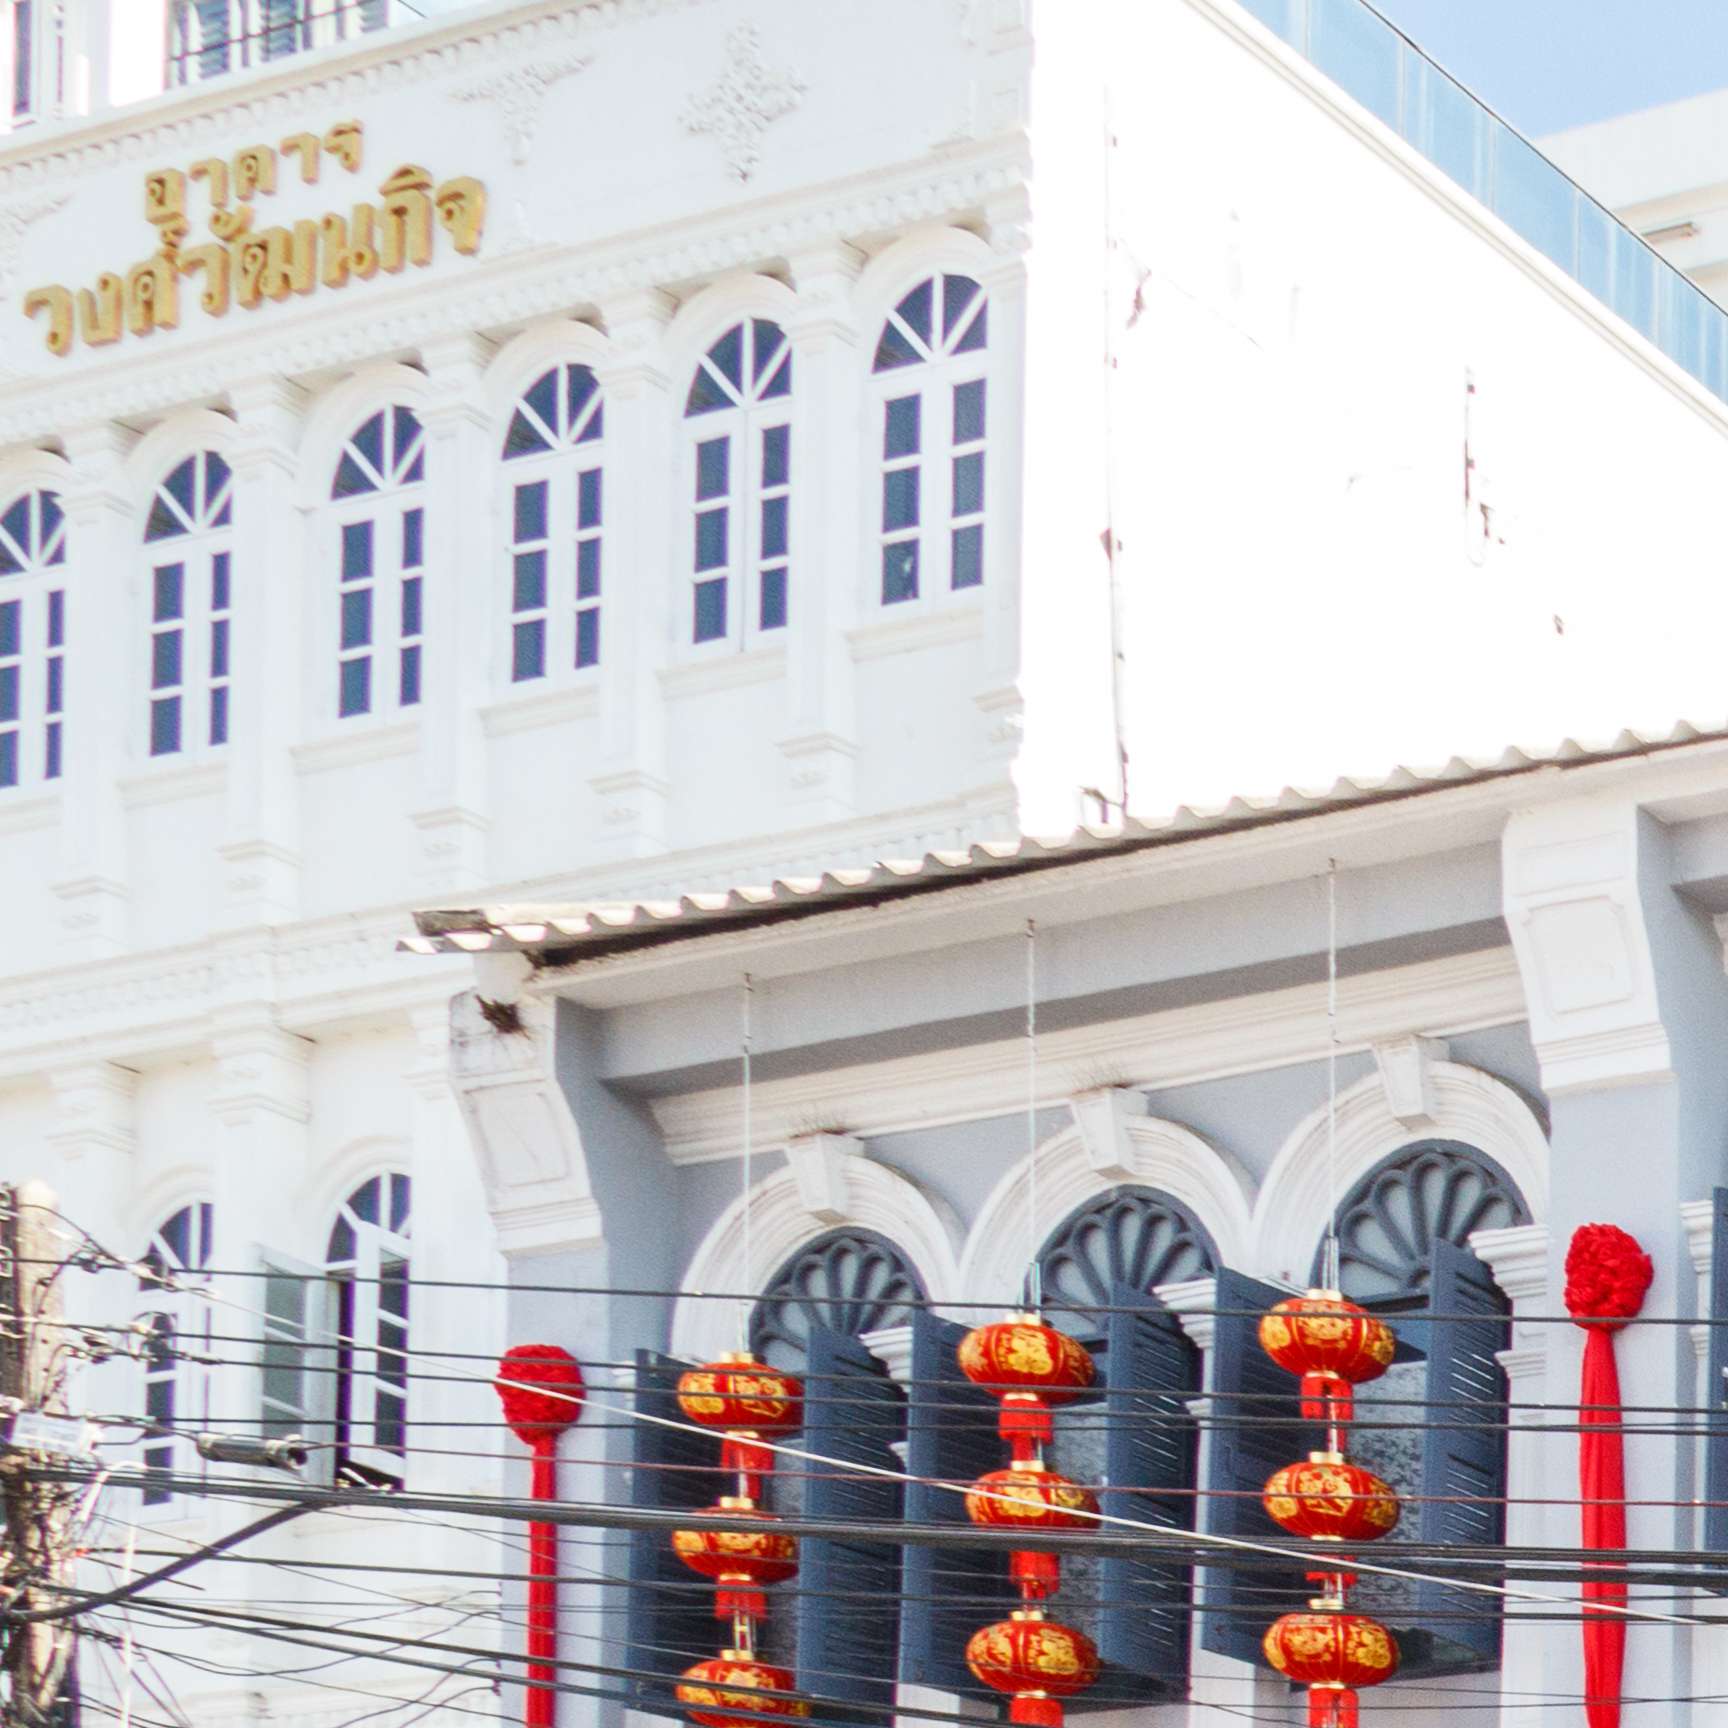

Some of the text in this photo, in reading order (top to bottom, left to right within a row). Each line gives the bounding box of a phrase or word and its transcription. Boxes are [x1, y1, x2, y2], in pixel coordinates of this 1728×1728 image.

[145, 118, 363, 223] อาคาร
[23, 163, 488, 357] วงศ์วัฒนกิจ
